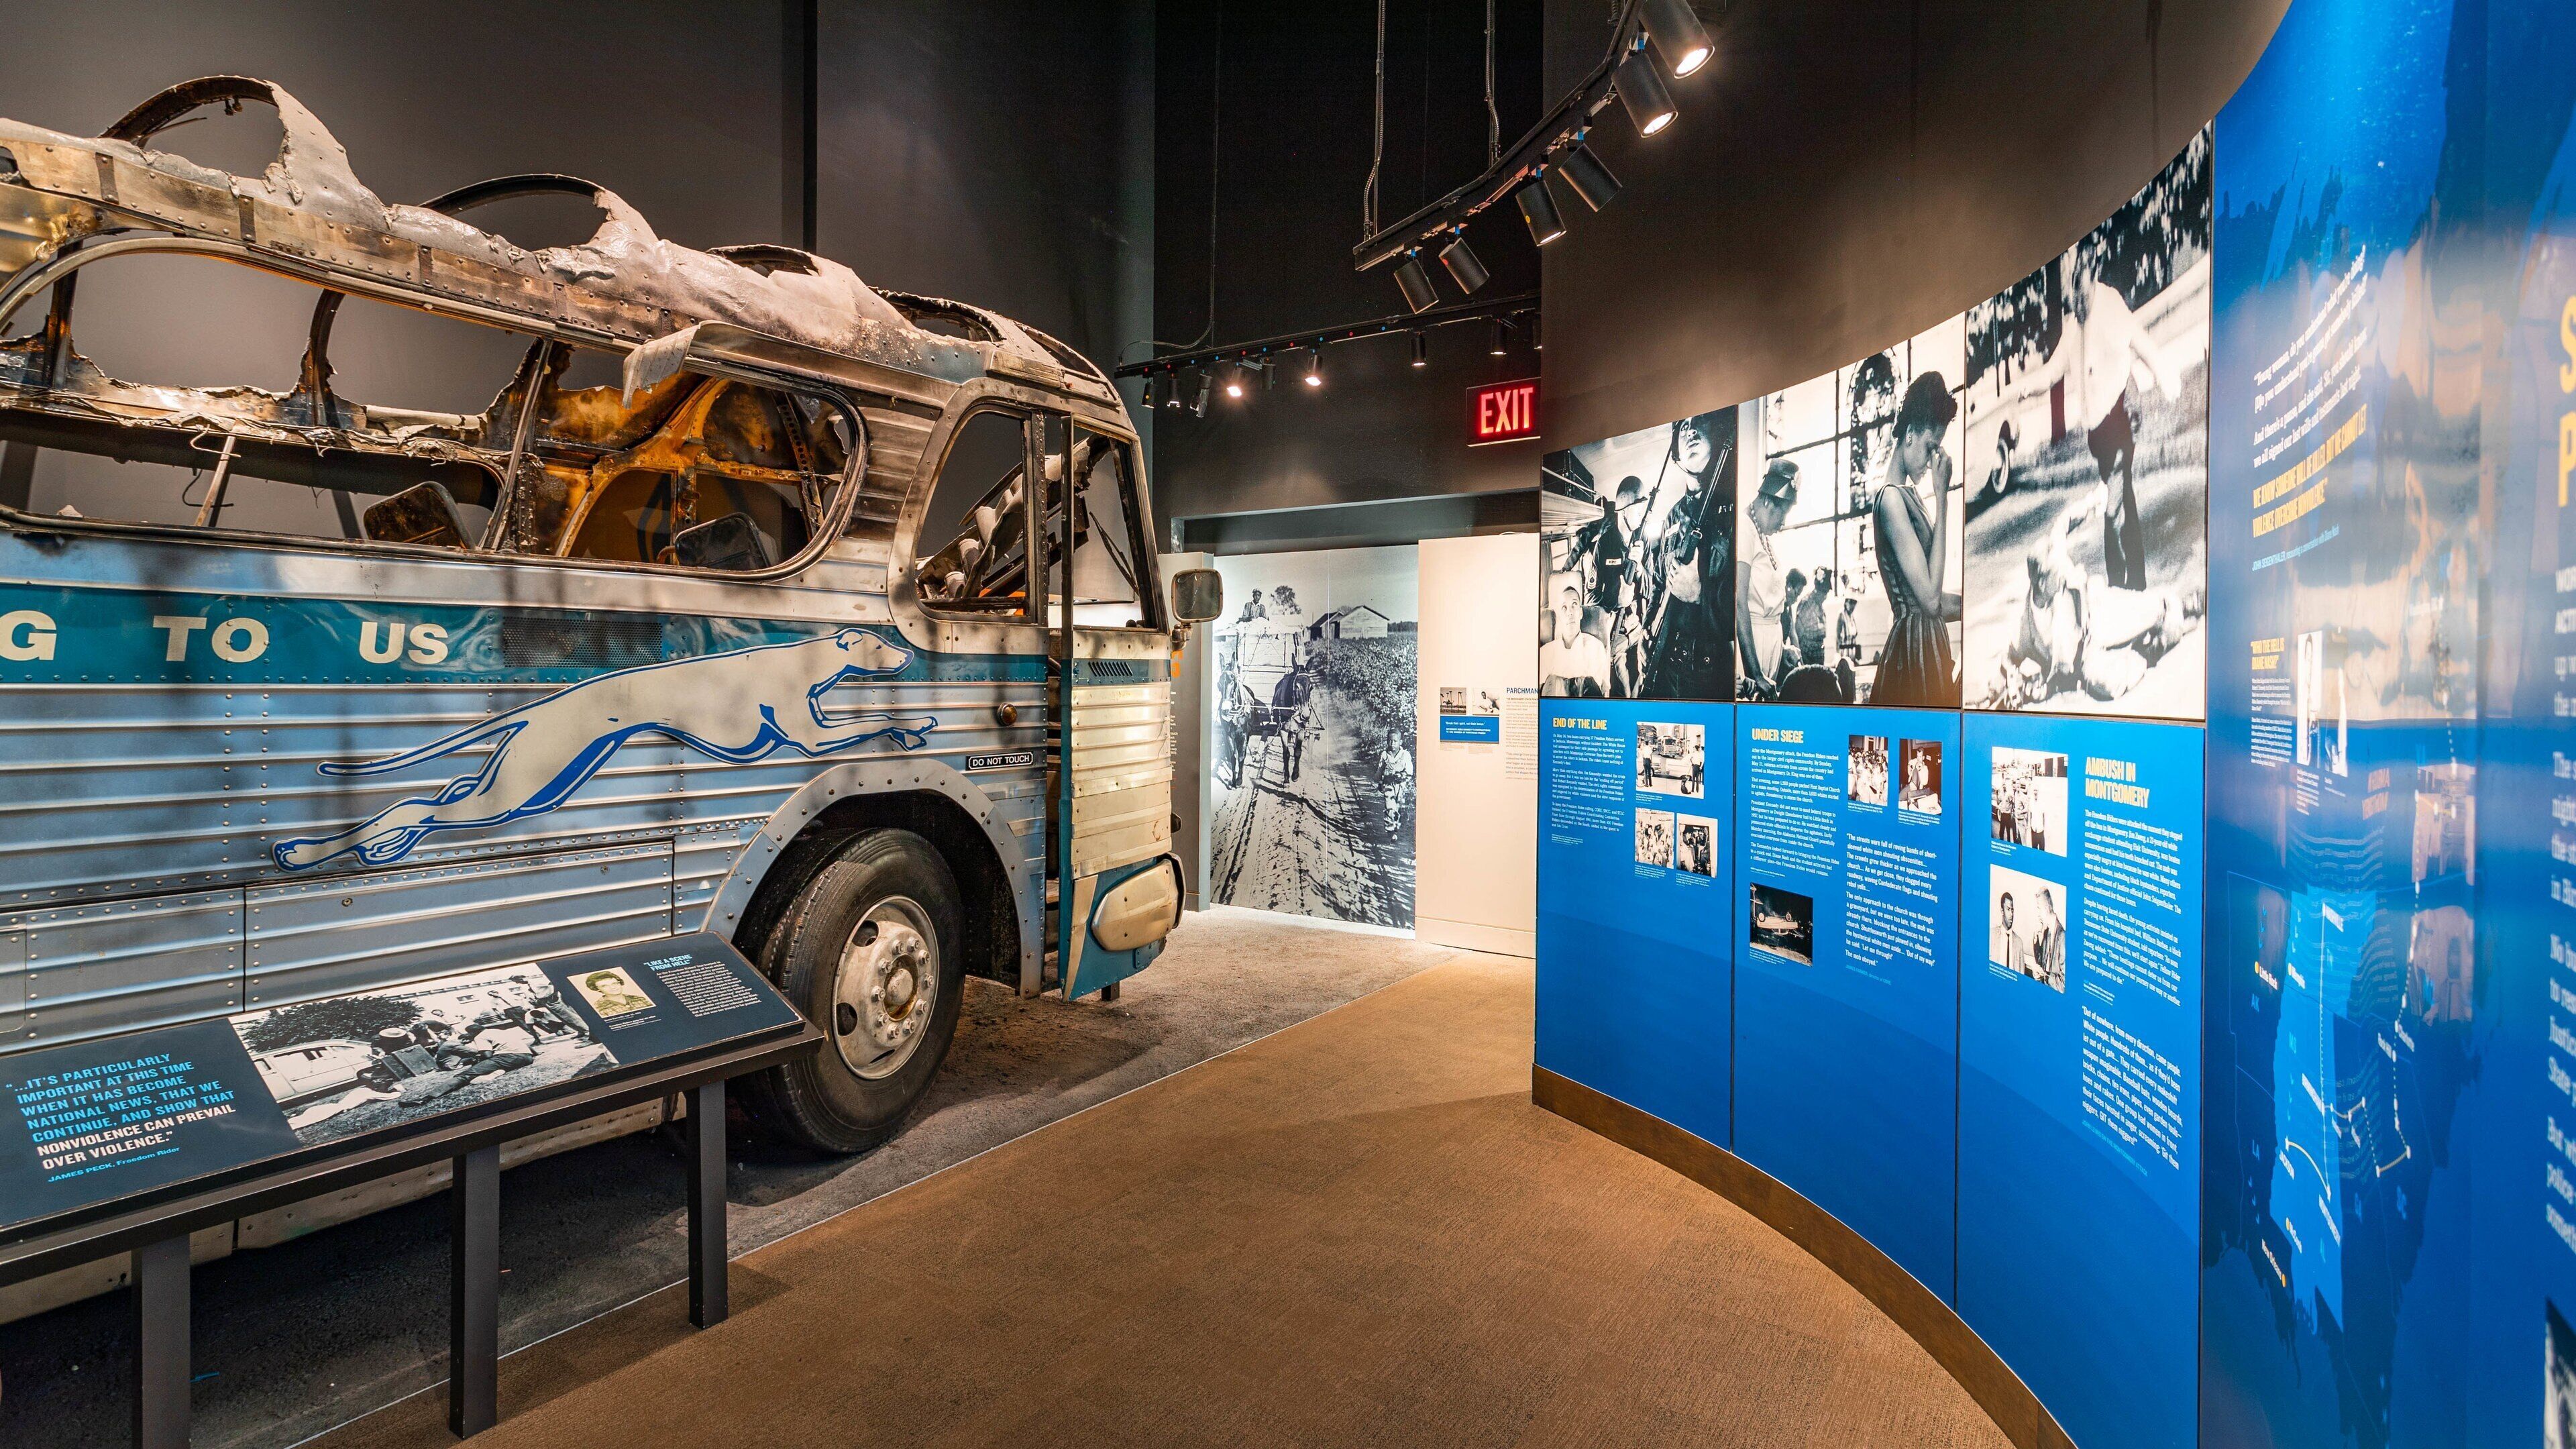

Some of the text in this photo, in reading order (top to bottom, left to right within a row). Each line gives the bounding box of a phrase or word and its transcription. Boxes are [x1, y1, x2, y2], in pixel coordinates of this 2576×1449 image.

[1481, 387, 1534, 434] EXIT
[0, 610, 448, 664] G TO US
[1552, 718, 1607, 730] END OF THE LINE
[1752, 728, 1804, 743] UNDER SIEGE
[973, 755, 1030, 766] DO NOT TOUCH
[2085, 757, 2136, 782] AMBUSH IN
[2553, 751, 2571, 778] The
[2085, 778, 2150, 808] MONTGOMERY
[643, 959, 663, 967] “LIKE
[669, 954, 693, 963] SCENE
[650, 959, 690, 971] FROM HELL”
[17, 1061, 195, 1104] IMPORTANT AT THIS TIME
[62, 1054, 170, 1081] PARTICULARLY
[2548, 1057, 2571, 1095] State
[20, 1075, 186, 1116] WHEN IT HAS BECOME
[27, 1081, 222, 1130] NATIONAL NEWS, THAT WE
[32, 1091, 234, 1142] CONTINUE, AND SHOW THAT
[37, 1104, 236, 1156] NONVIOLENCE CAN PREVAIL
[42, 1131, 172, 1169] OVER VIOLENCE.”
[48, 1147, 180, 1182] JAMES PECK, Freedom Rider
